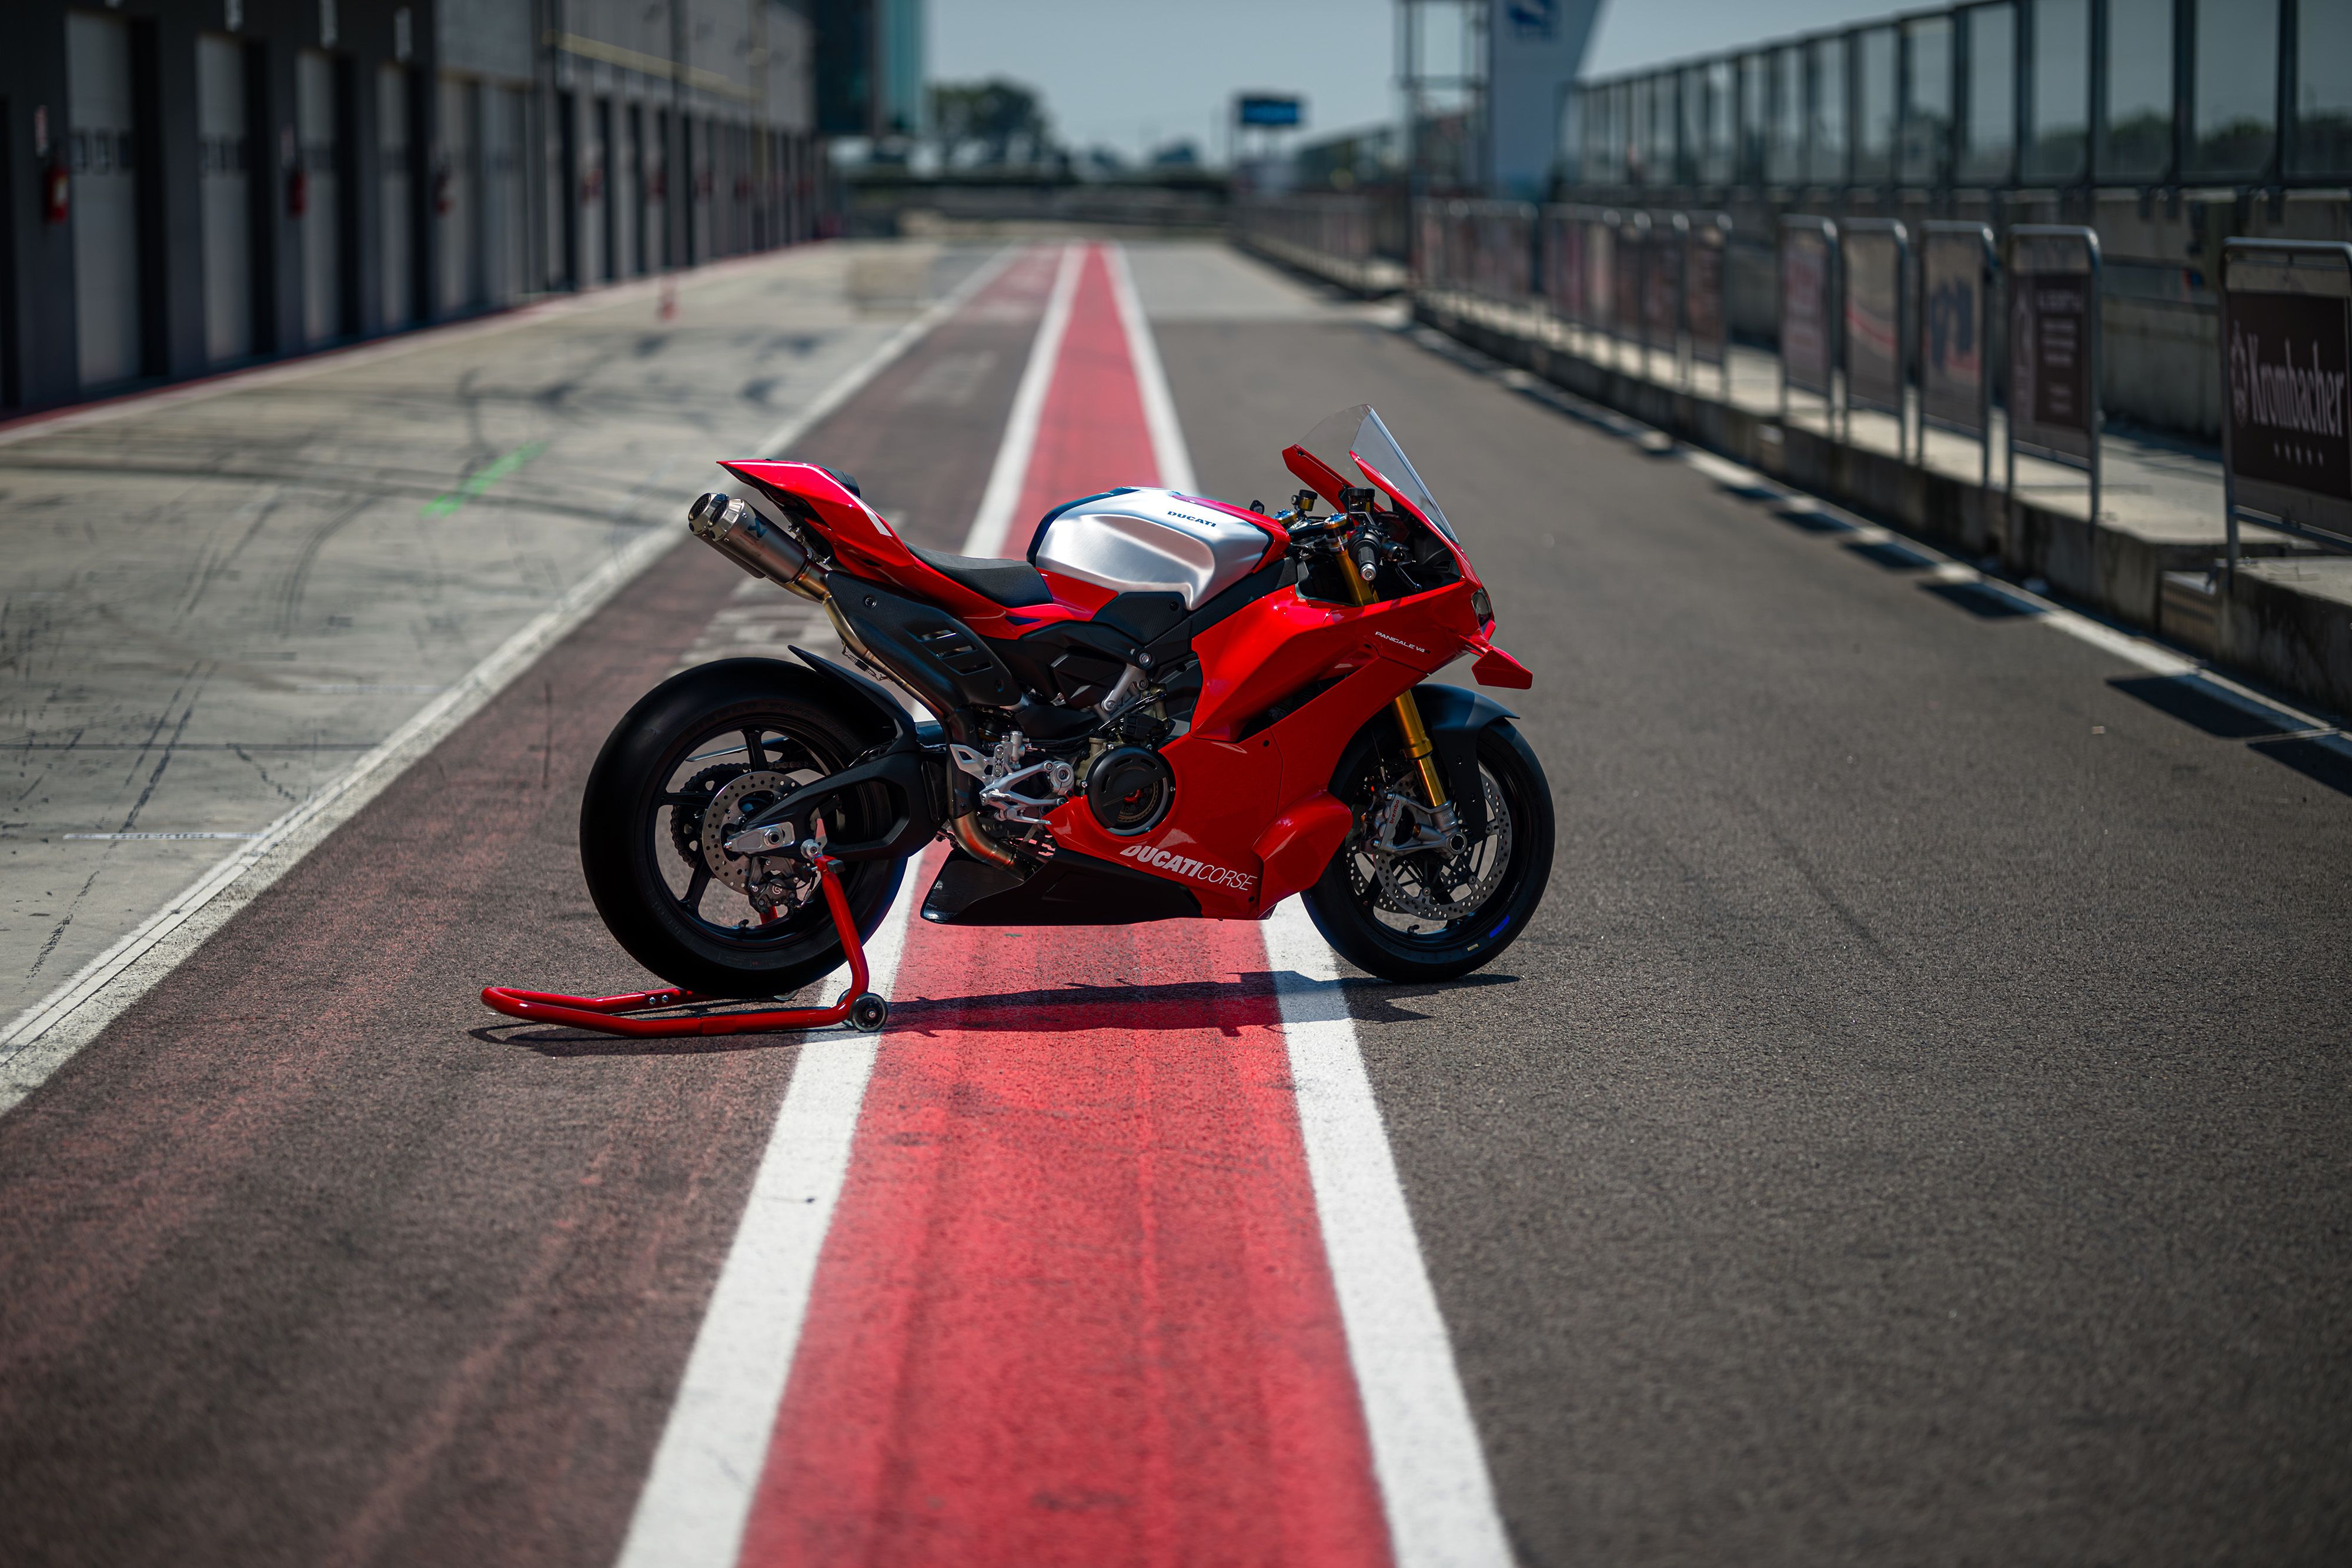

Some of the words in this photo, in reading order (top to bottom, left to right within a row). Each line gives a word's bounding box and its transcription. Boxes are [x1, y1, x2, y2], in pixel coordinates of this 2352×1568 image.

[2247, 332, 2345, 438] Krombacher
[1167, 510, 1217, 527] DUCATI
[1375, 631, 1415, 649] PANIGALE
[1389, 800, 1400, 824] brembo
